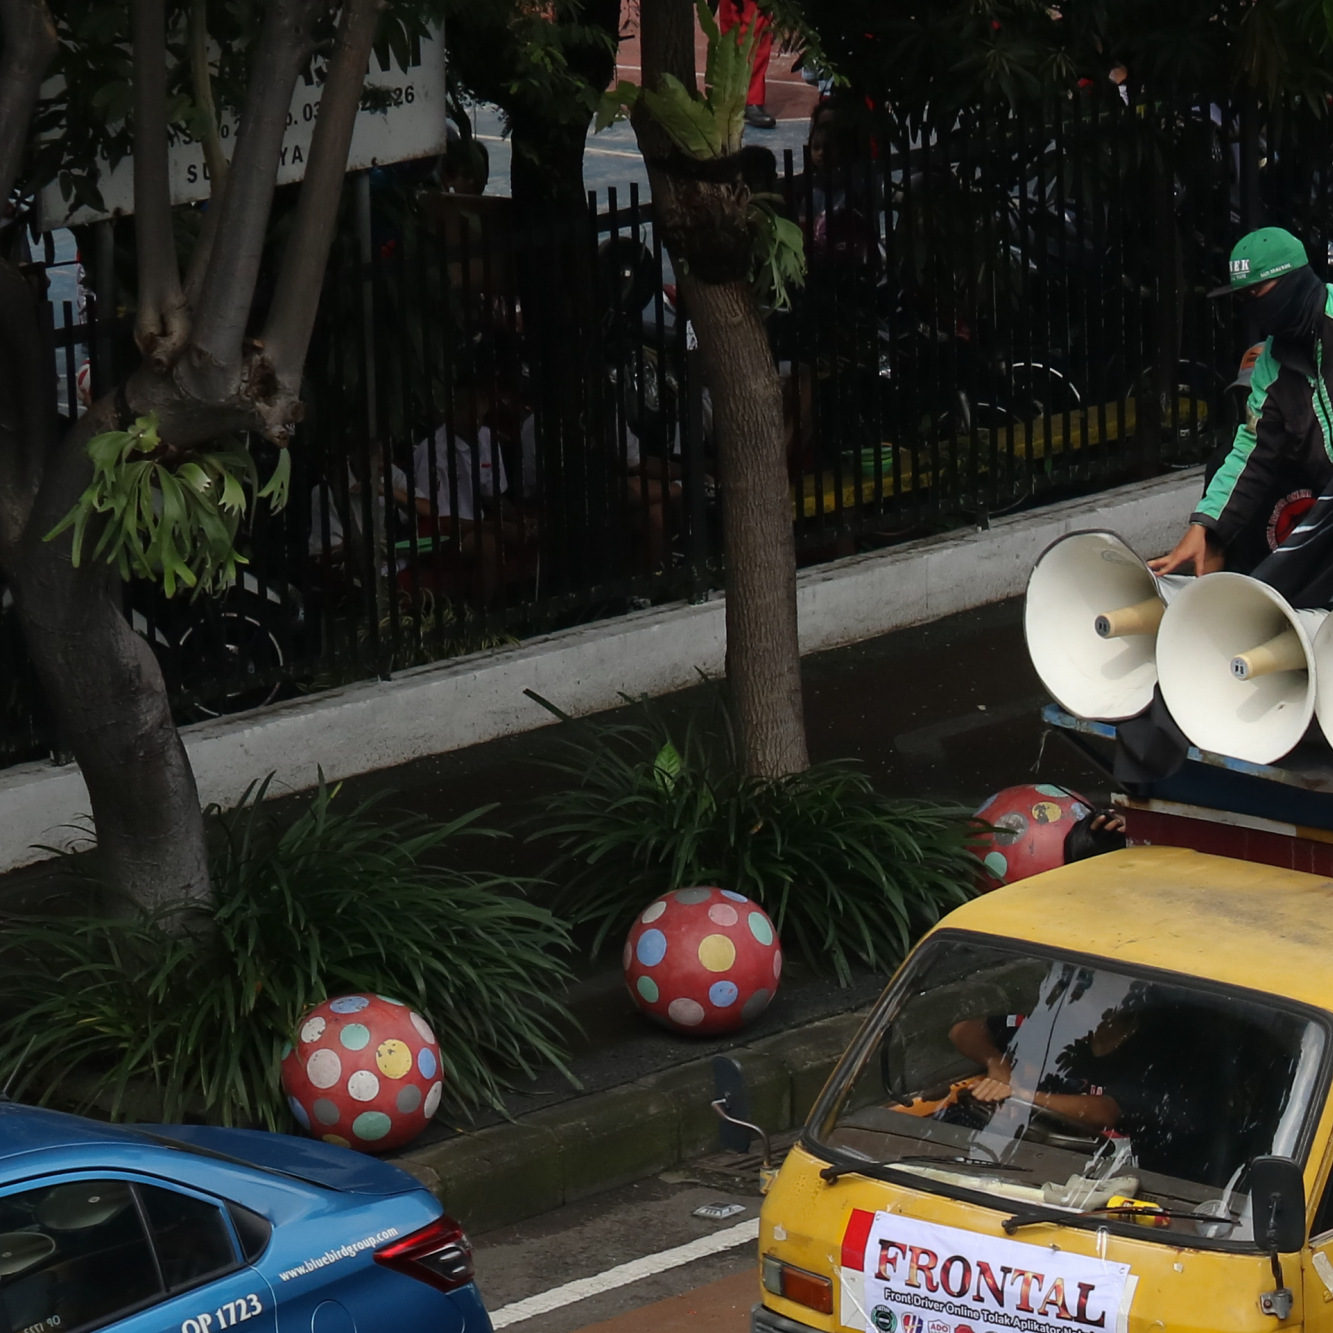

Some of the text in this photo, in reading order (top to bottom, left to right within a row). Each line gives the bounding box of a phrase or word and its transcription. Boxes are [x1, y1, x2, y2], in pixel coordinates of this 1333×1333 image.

[279, 1226, 398, 1282] www.bluebirdgroup.com
[874, 1239, 1106, 1328] FRONTAL
[215, 1293, 263, 1330] 1723
[884, 1287, 912, 1306] Front
[913, 1293, 945, 1313] Driver
[945, 1299, 980, 1320] Online
[981, 1307, 1010, 1326] Tolak
[930, 1323, 948, 1333] ADO
